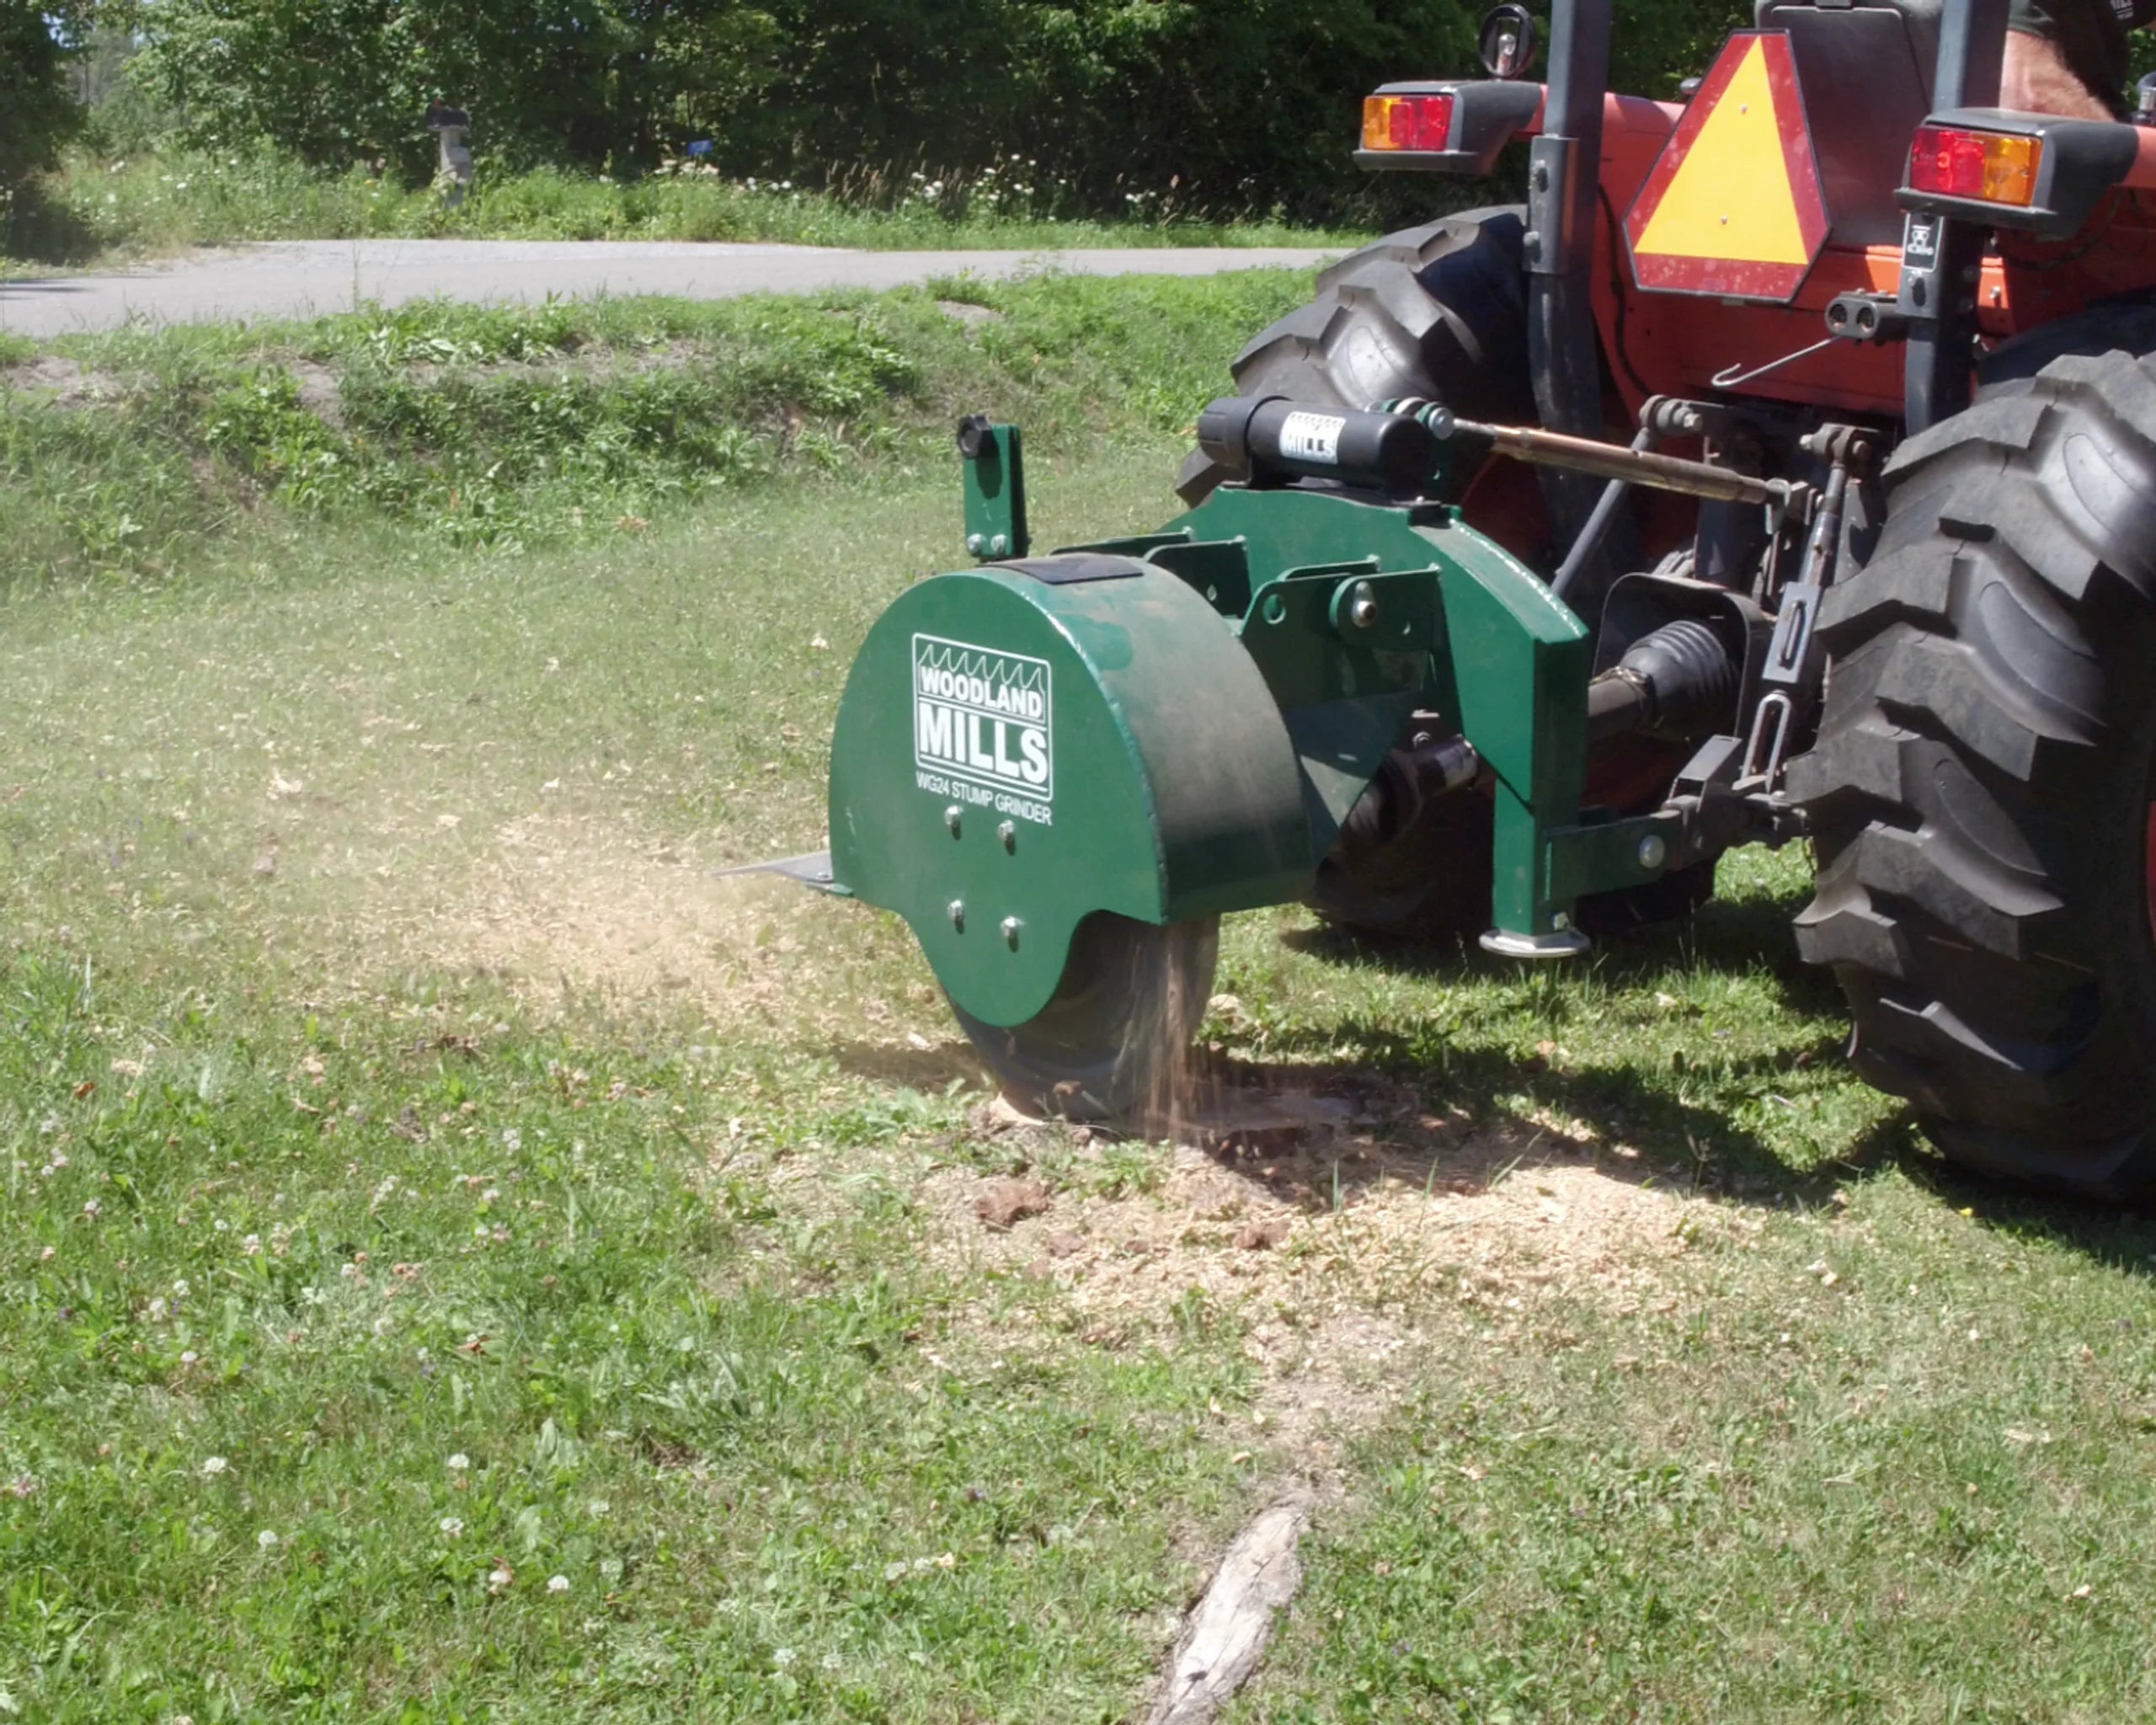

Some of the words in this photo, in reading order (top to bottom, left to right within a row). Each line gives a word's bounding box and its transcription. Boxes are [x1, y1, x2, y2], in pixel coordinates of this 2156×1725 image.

[920, 665, 1043, 718] WOODLAND
[919, 702, 1048, 783] MILLS
[916, 772, 949, 795] WG24
[952, 782, 993, 806] STUMP
[995, 793, 1052, 825] GRINDER
